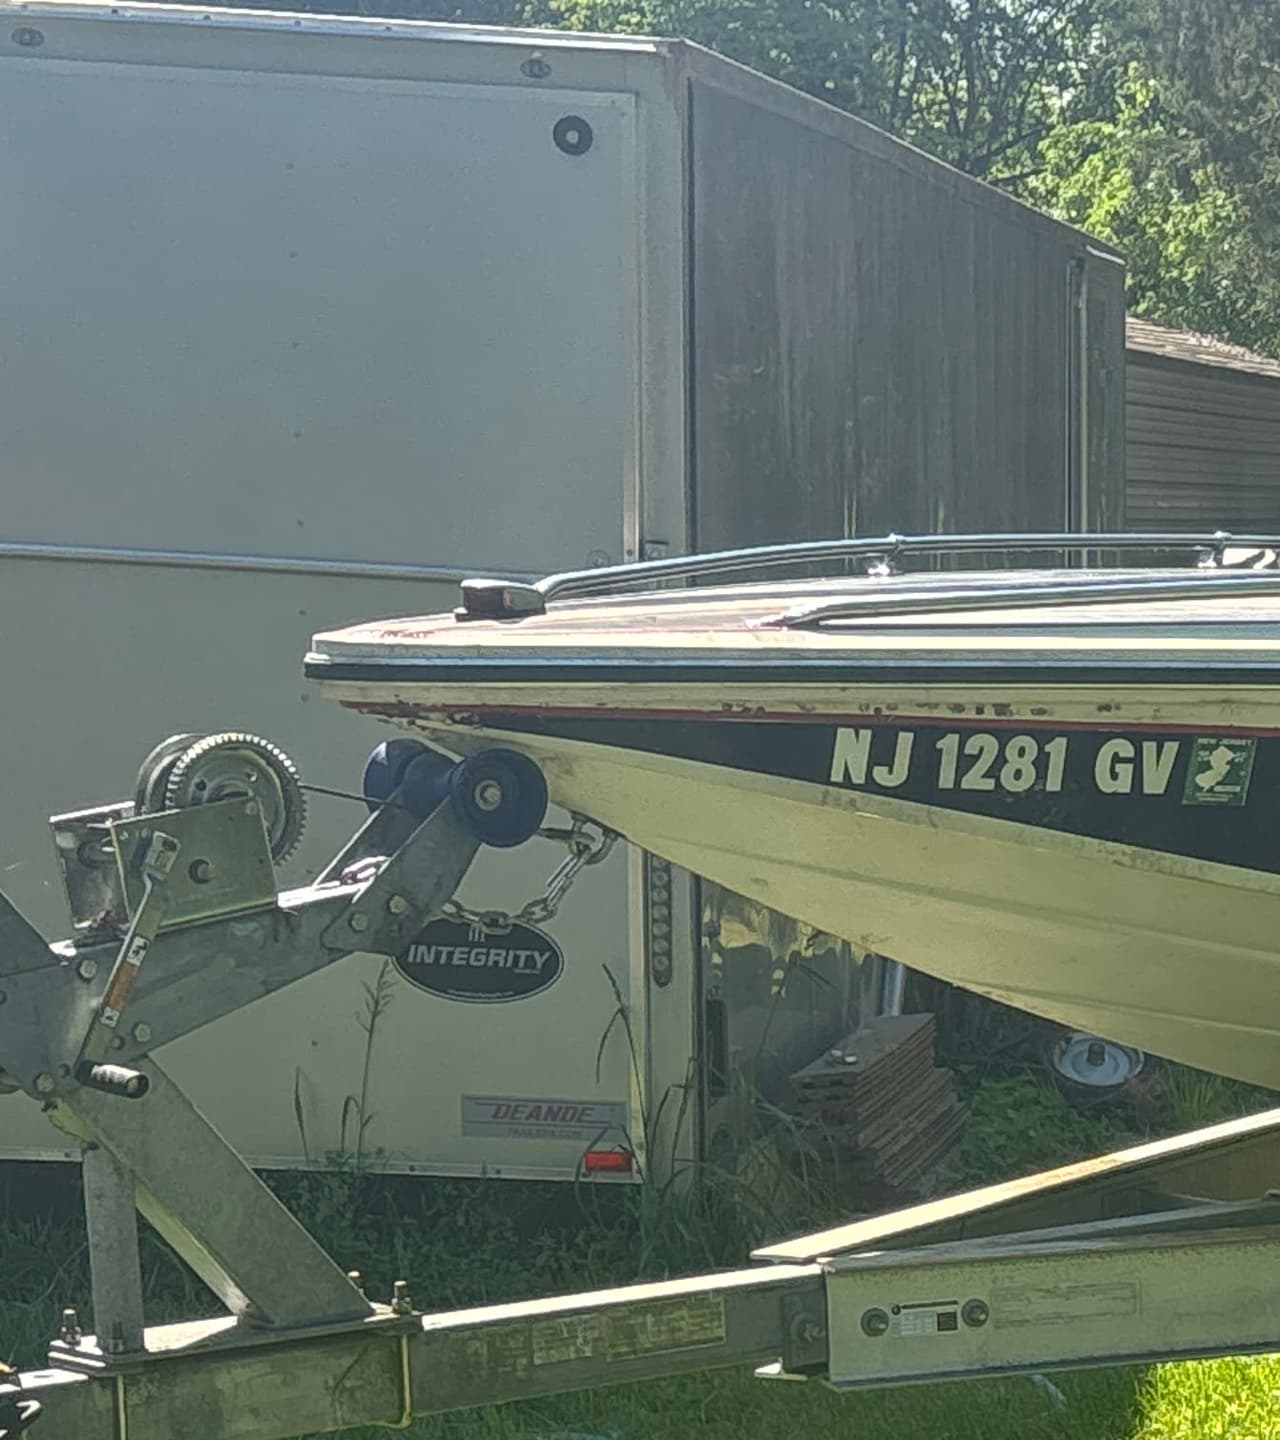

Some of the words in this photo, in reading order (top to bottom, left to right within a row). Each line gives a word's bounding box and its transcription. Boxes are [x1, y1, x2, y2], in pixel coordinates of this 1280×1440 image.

[830, 727, 915, 788] NJ
[935, 732, 1069, 793] 1281
[1094, 738, 1180, 795] GV
[407, 944, 552, 969] INTEGRITY
